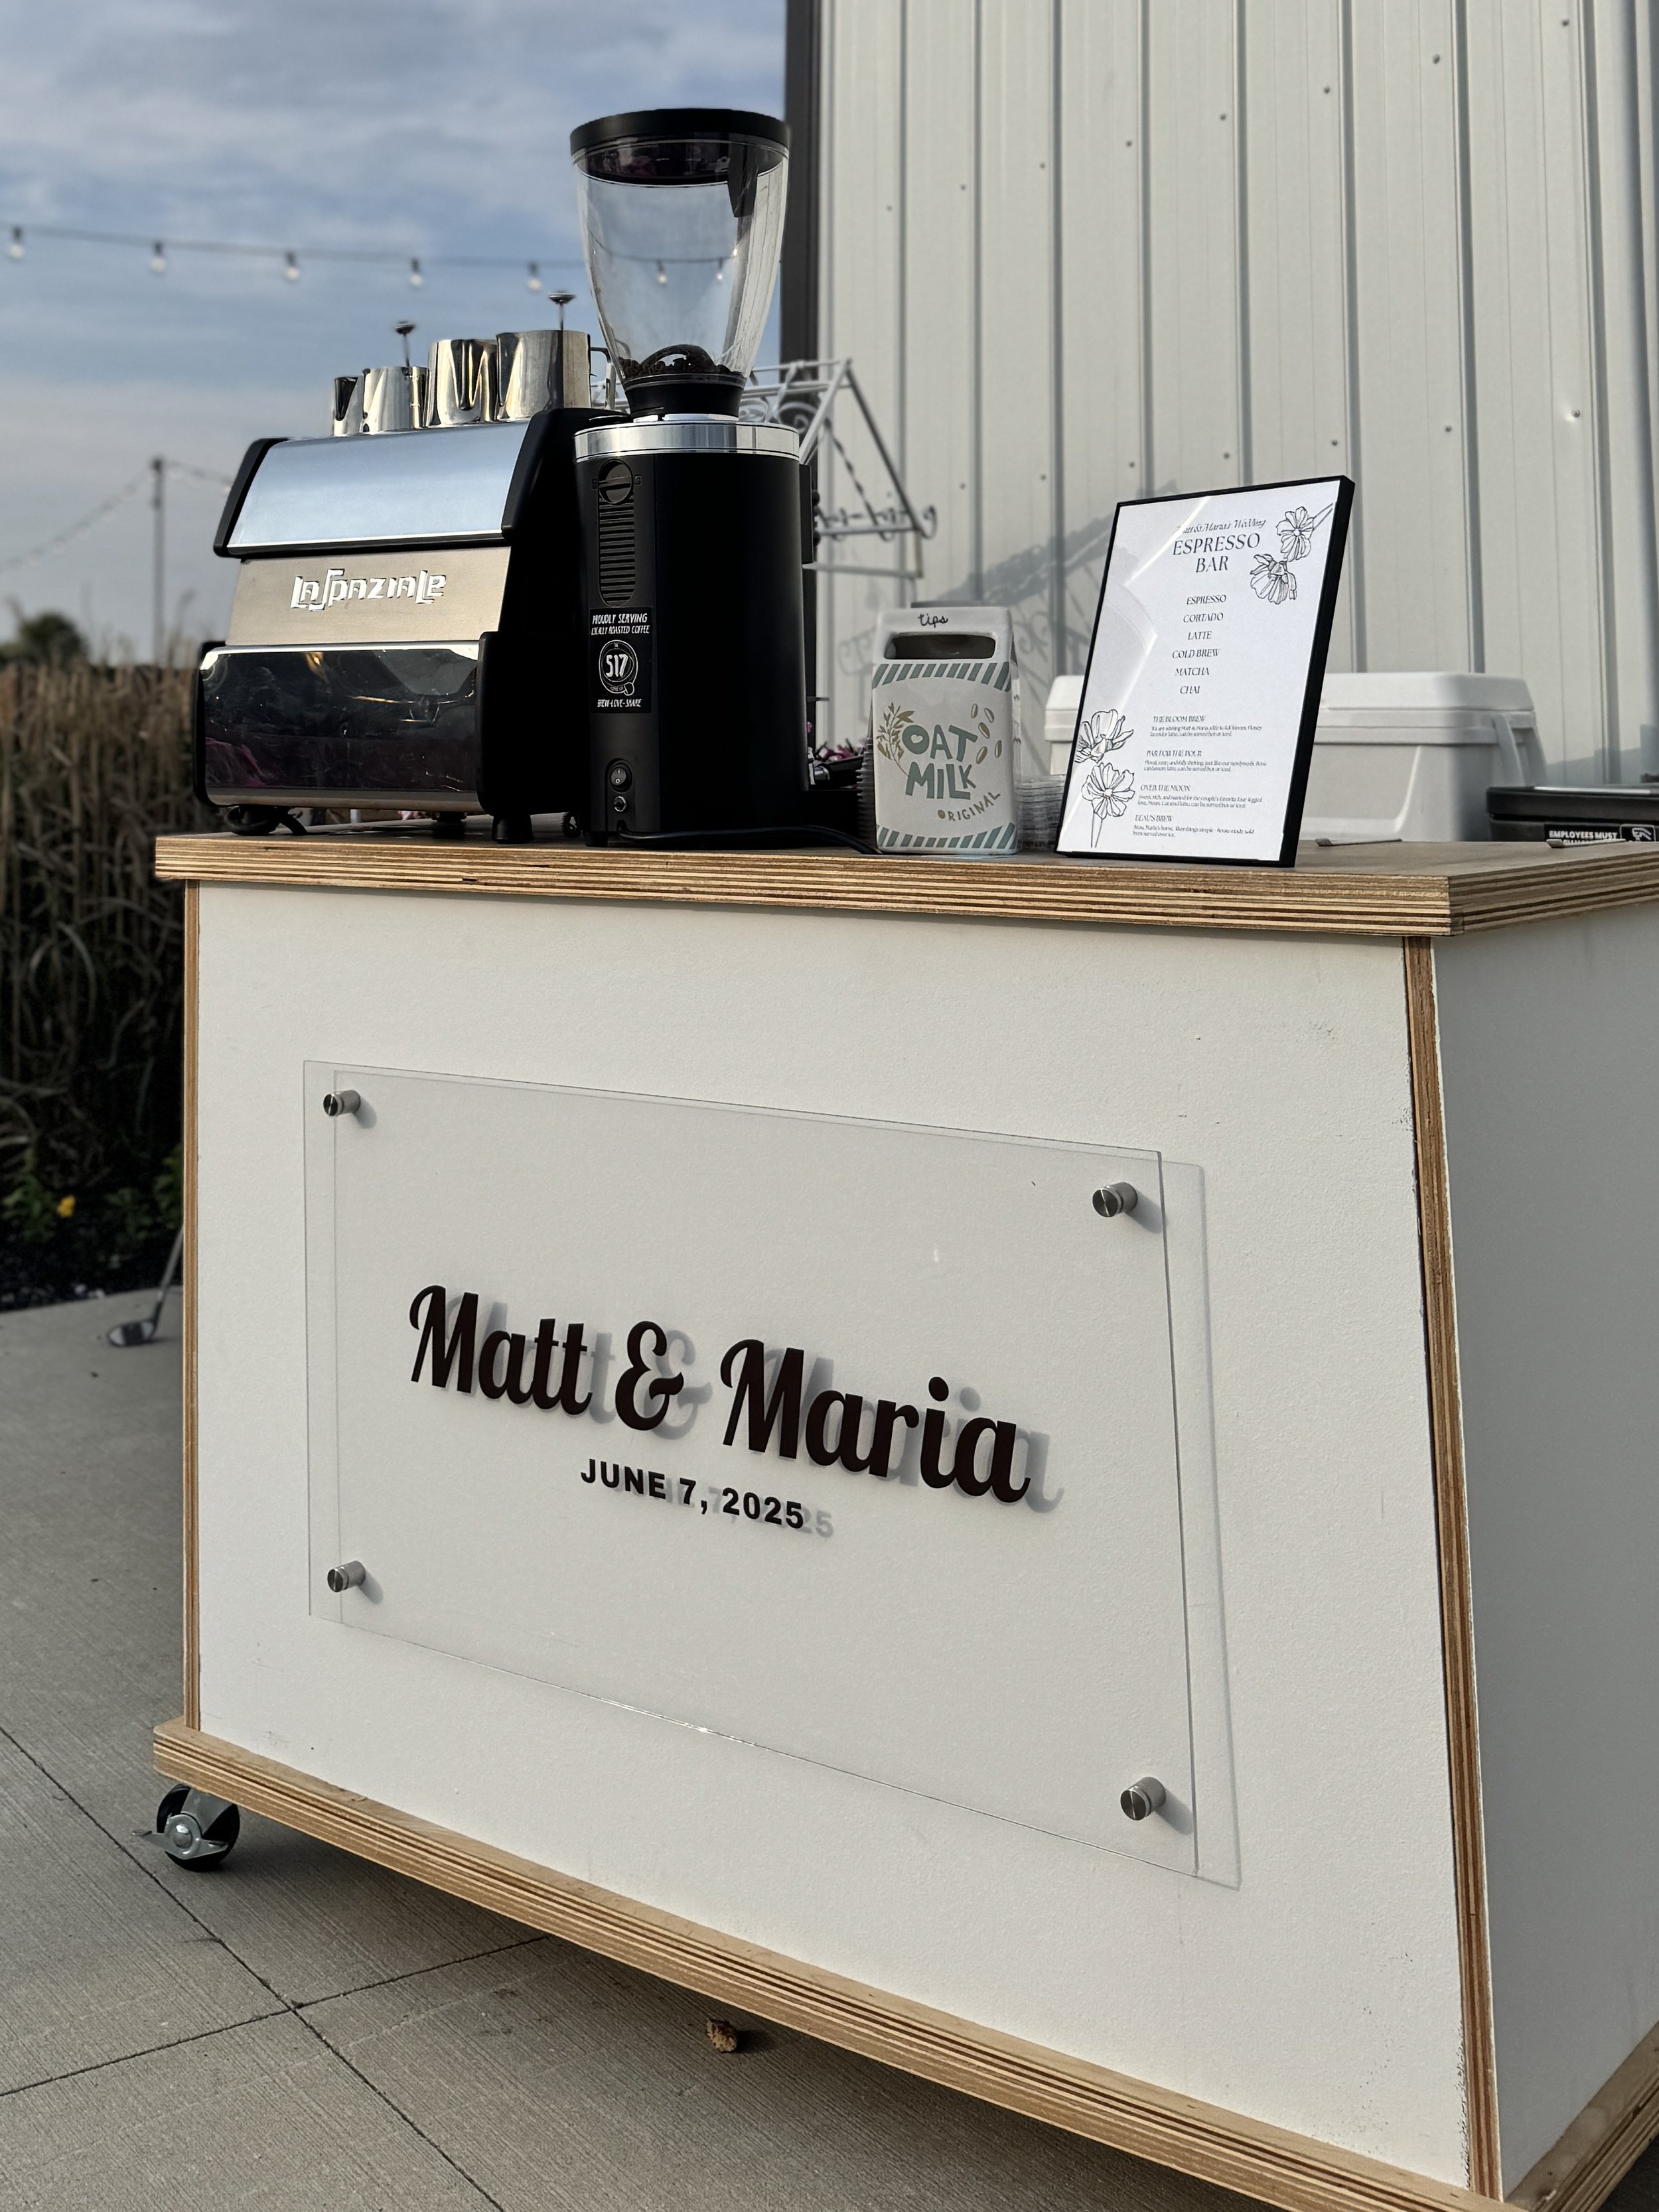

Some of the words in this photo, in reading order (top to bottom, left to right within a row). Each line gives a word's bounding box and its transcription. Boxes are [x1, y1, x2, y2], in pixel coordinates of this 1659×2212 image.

[1173, 532, 1261, 555] ESPRESSO
[1195, 555, 1229, 573] BAR
[1187, 594, 1227, 605] ESPRESSO
[618, 612, 648, 624] SERVING
[918, 612, 949, 628] tips
[1183, 612, 1224, 623] CORTADO
[609, 626, 630, 634] ROASTED
[631, 625, 650, 634] COFFEE
[1188, 630, 1212, 640] LATTE
[1172, 649, 1195, 659] COLD
[1196, 648, 1220, 658] BREW
[605, 654, 629, 677] 517
[1175, 667, 1210, 676] MATCHA
[1179, 685, 1200, 694] CHAI
[902, 725, 978, 762] OAT
[905, 761, 976, 801] MILK
[937, 791, 1001, 821] ORIGINAL
[1549, 830, 1594, 839] EMPLOYEES
[1595, 831, 1618, 840] MUST
[409, 1285, 593, 1416] Matt
[615, 1320, 684, 1432] &
[720, 1339, 1031, 1504] Maria
[581, 1458, 666, 1499] JUNE
[680, 1478, 708, 1515] 7,
[722, 1487, 804, 1530] 2025
